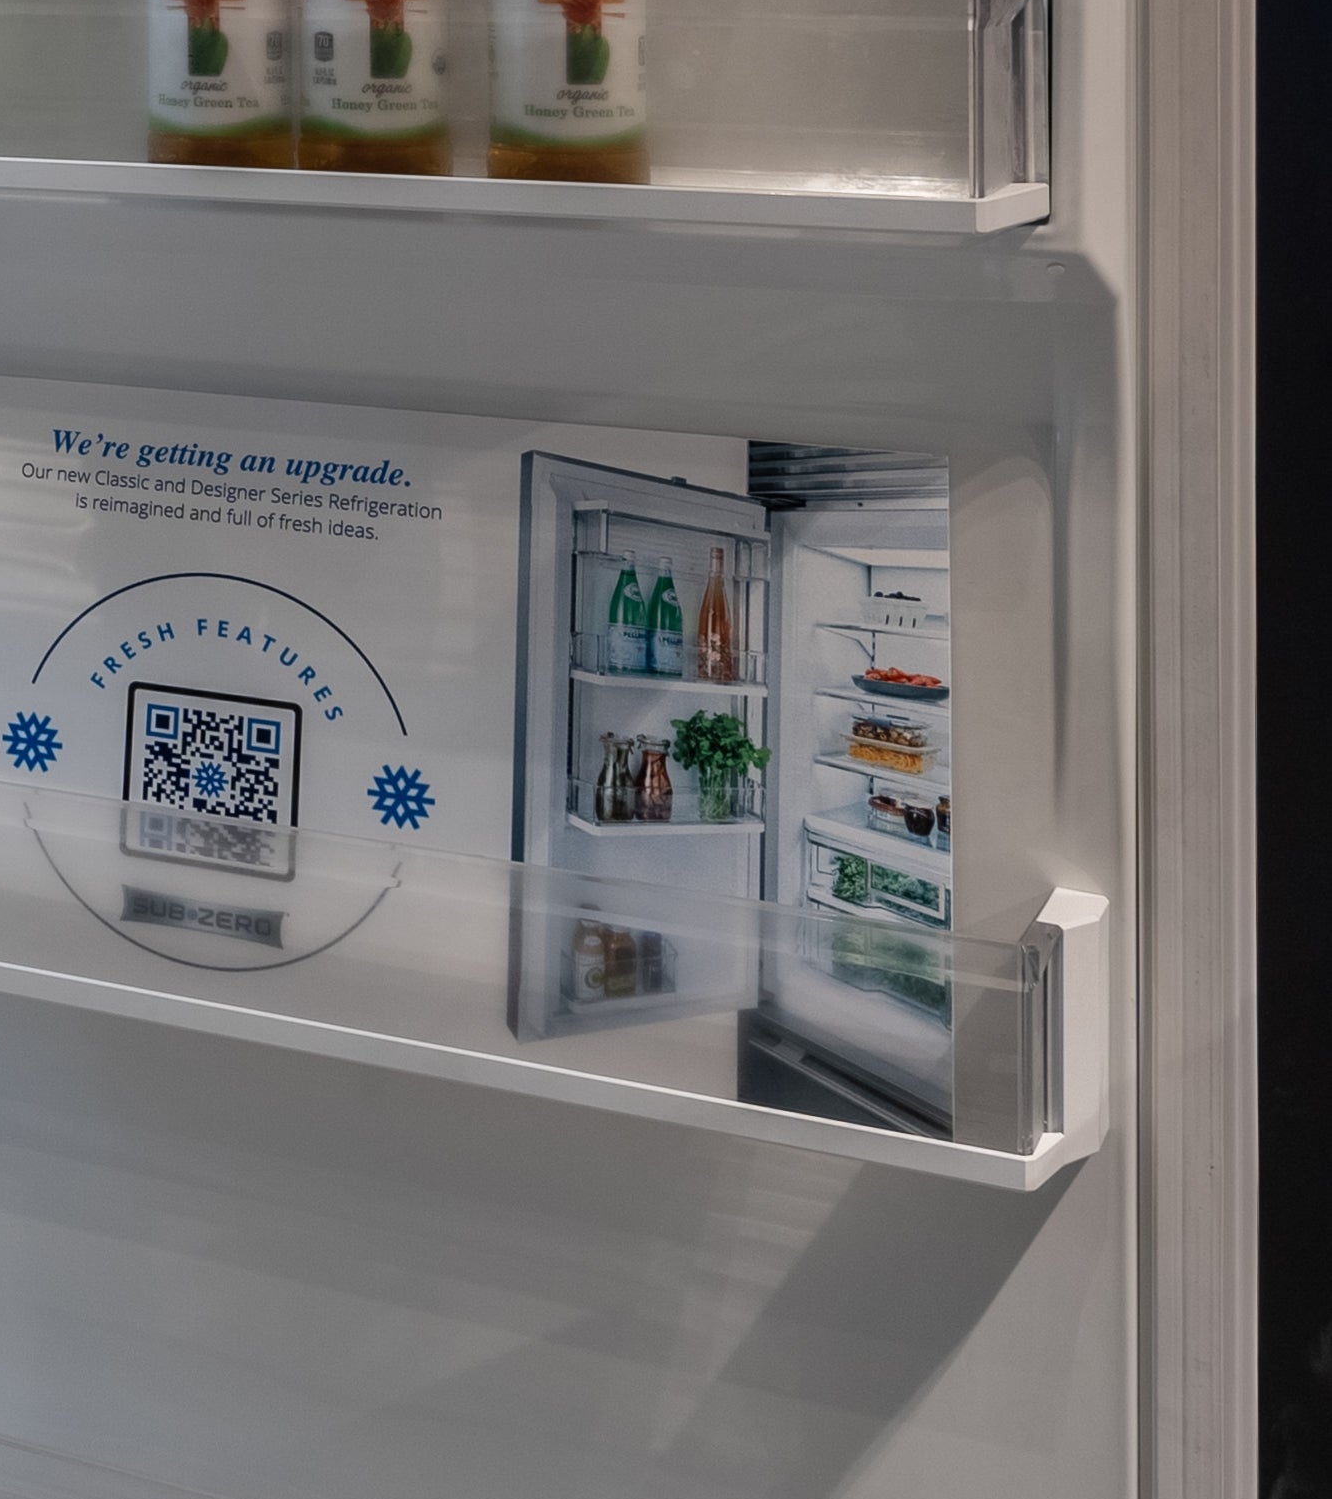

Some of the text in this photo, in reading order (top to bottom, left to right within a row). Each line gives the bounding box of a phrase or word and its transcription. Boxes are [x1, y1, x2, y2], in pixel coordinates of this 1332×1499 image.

[180, 79, 229, 97] organic
[361, 81, 413, 98] organic
[158, 93, 260, 109] Honey Green Tea
[331, 97, 418, 113] Honey Green
[556, 89, 609, 105] organic
[524, 104, 568, 120] Honey
[572, 106, 614, 118] Green
[52, 428, 412, 488] We're getting an upgrade.
[21, 462, 443, 521] Our new Classic and Designer Series Refrigeration
[75, 493, 379, 540] is reimagined and full of fresh ideas.
[90, 618, 344, 722] FRESH FEATURES
